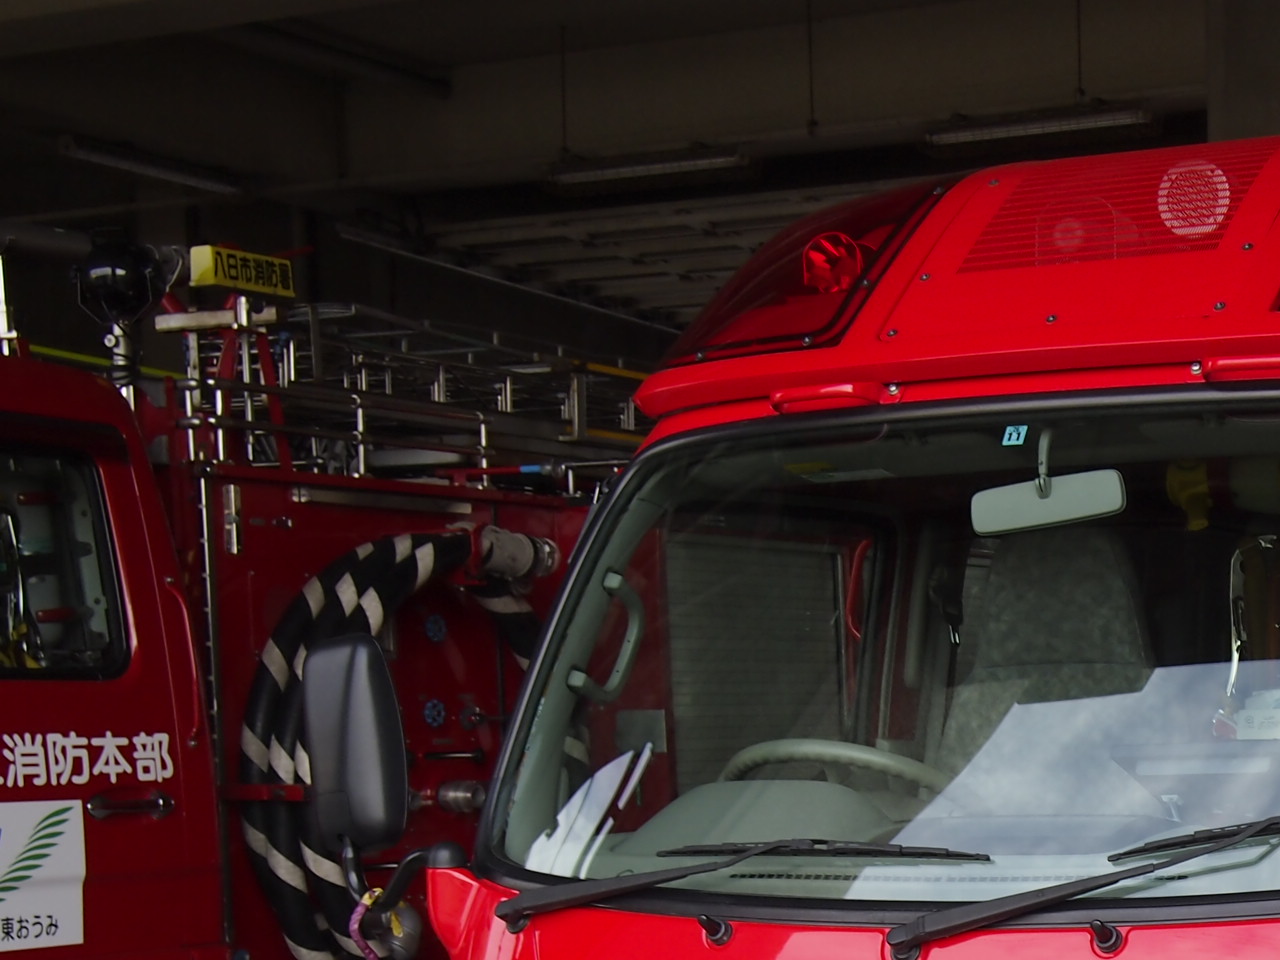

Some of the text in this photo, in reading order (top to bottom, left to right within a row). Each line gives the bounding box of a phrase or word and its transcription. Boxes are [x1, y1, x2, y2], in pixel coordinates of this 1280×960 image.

[214, 251, 291, 291] 八日市消防署
[0, 730, 175, 788] 消防本部
[1, 915, 60, 942] 東おうみ
